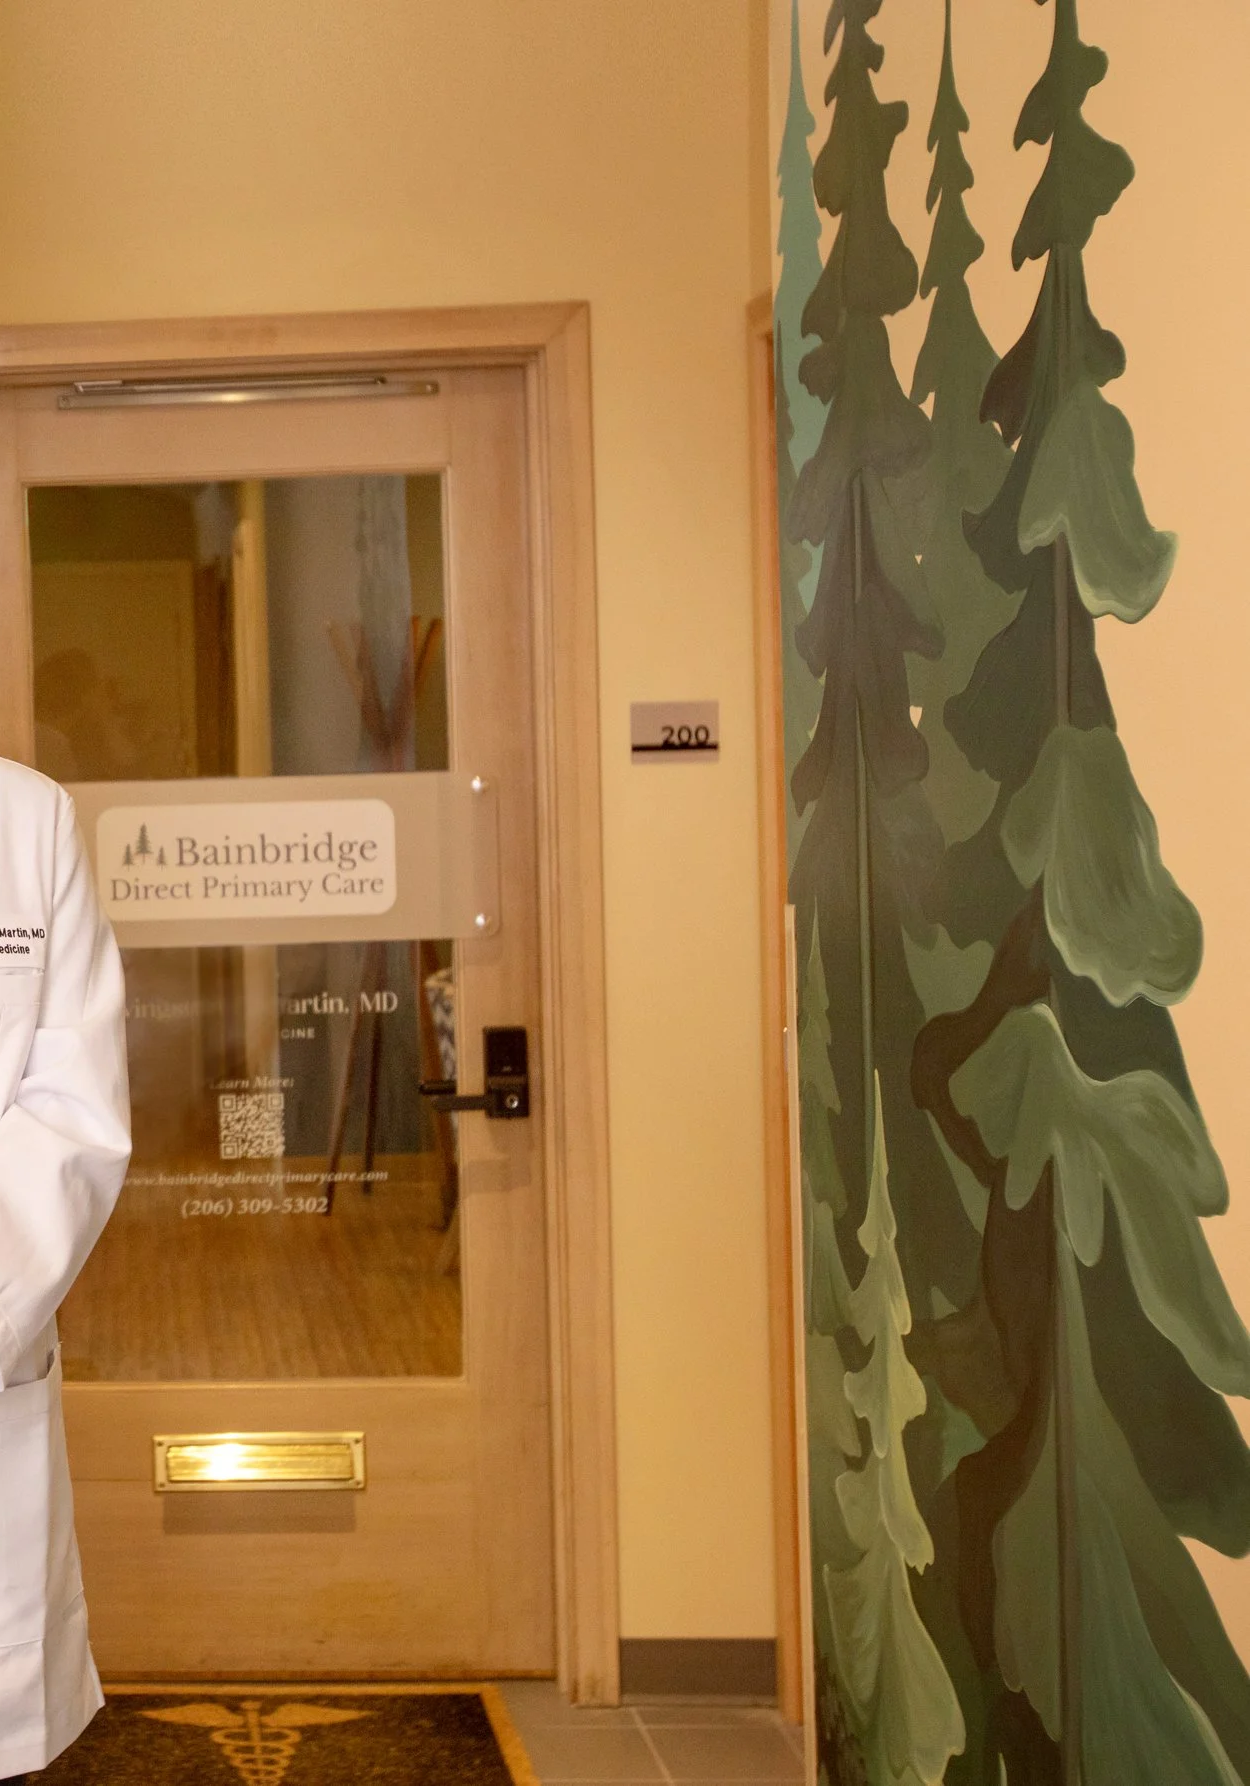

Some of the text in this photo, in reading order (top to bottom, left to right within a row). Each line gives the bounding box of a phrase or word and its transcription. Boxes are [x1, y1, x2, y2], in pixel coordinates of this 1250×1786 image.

[661, 725, 709, 748] 200
[175, 832, 378, 870] Bainbridge
[110, 871, 384, 903] Direct Primary Care
[31, 928, 46, 939] MD
[360, 991, 398, 1013] MD
[181, 1196, 329, 1219] (206) 309-5302
